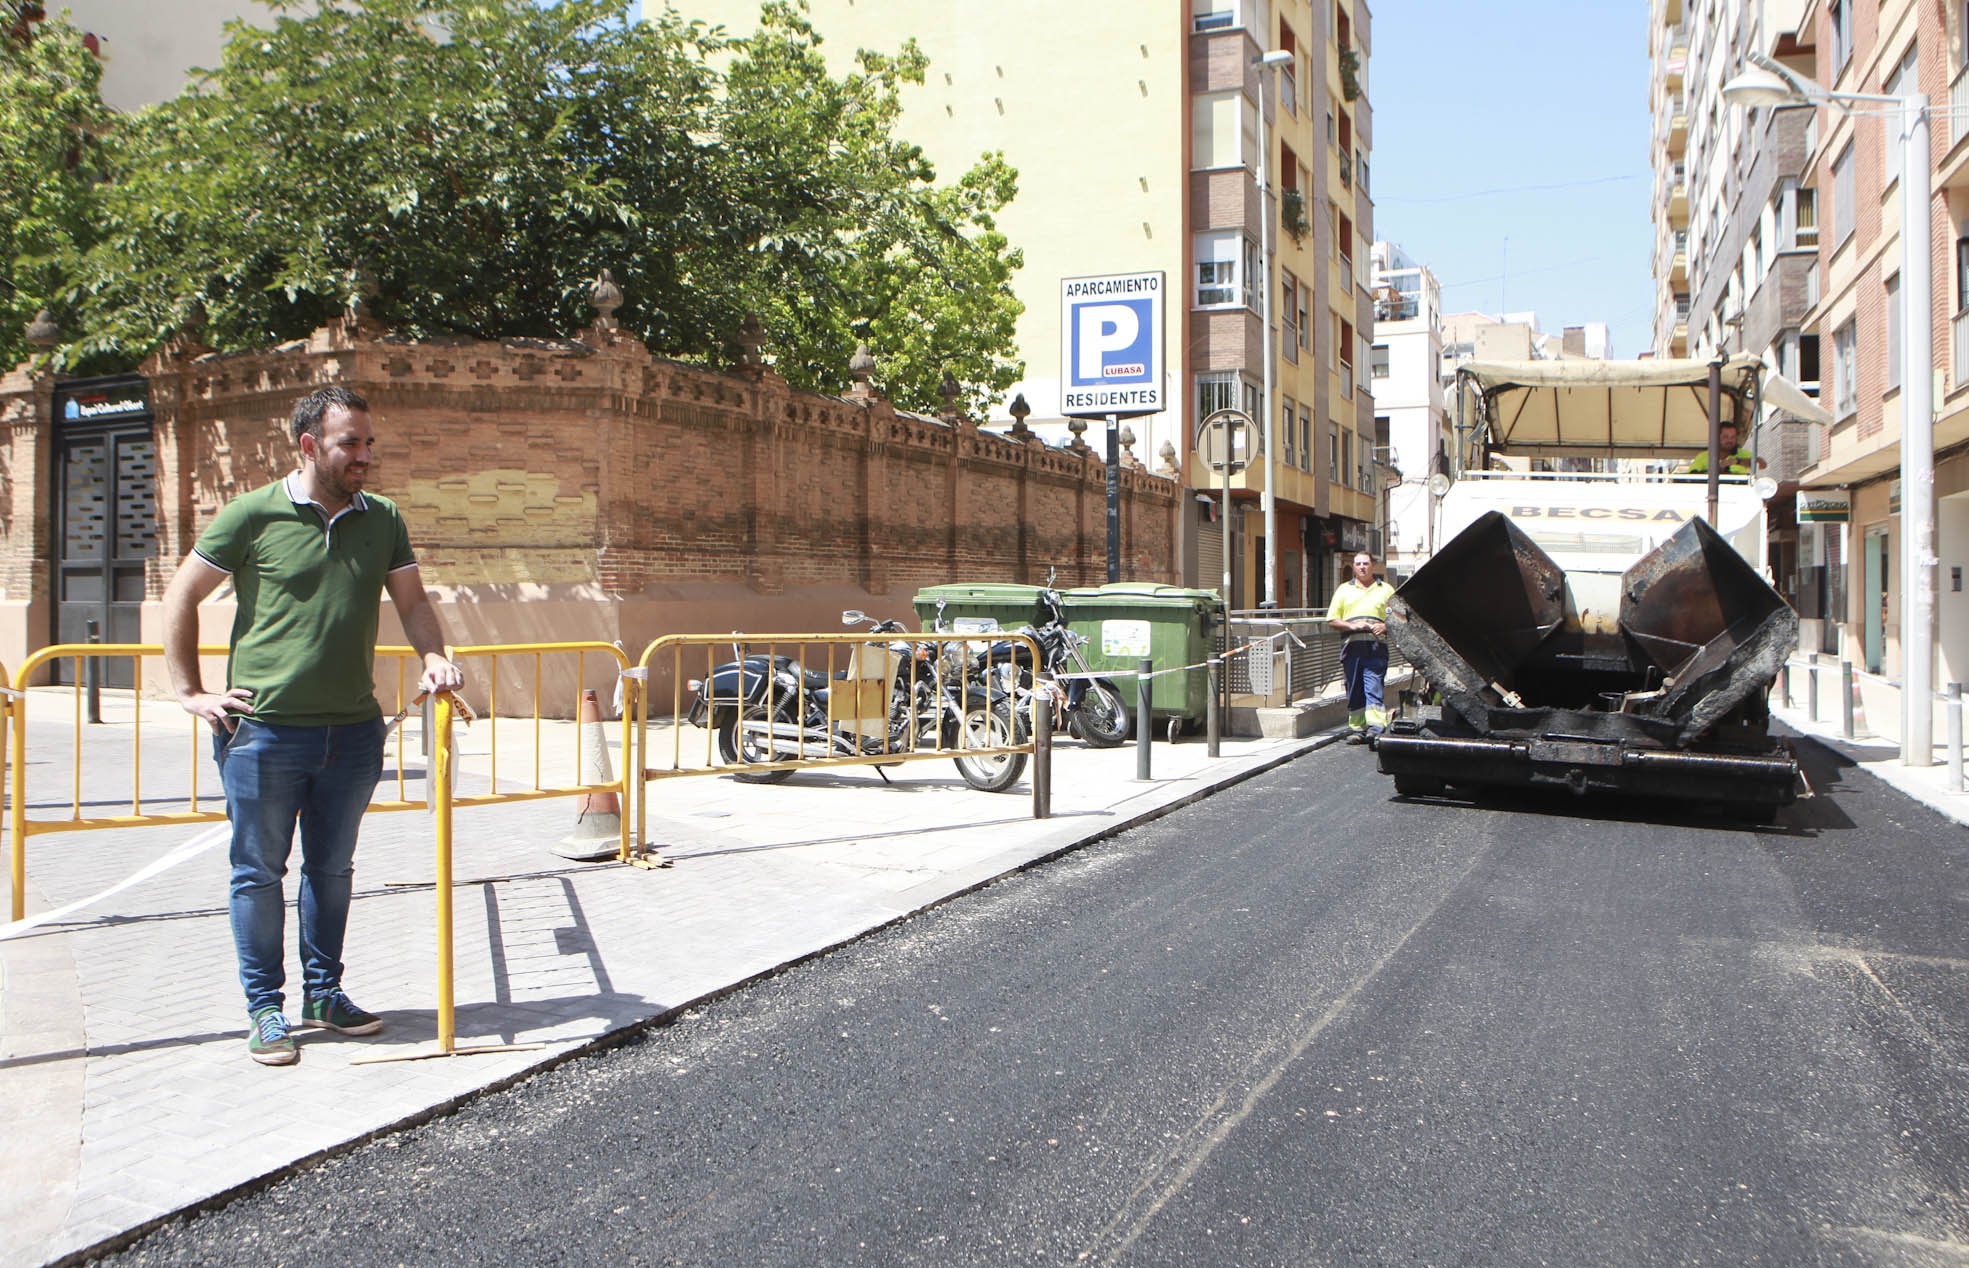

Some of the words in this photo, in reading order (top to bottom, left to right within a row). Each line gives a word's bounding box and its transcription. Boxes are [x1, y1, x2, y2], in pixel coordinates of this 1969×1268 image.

[1066, 277, 1158, 297] APARCAMIENTO
[1079, 304, 1139, 380] P
[1105, 365, 1142, 375] LUBASA
[1066, 390, 1157, 407] RESIDENTES
[1511, 506, 1684, 522] BECSA
